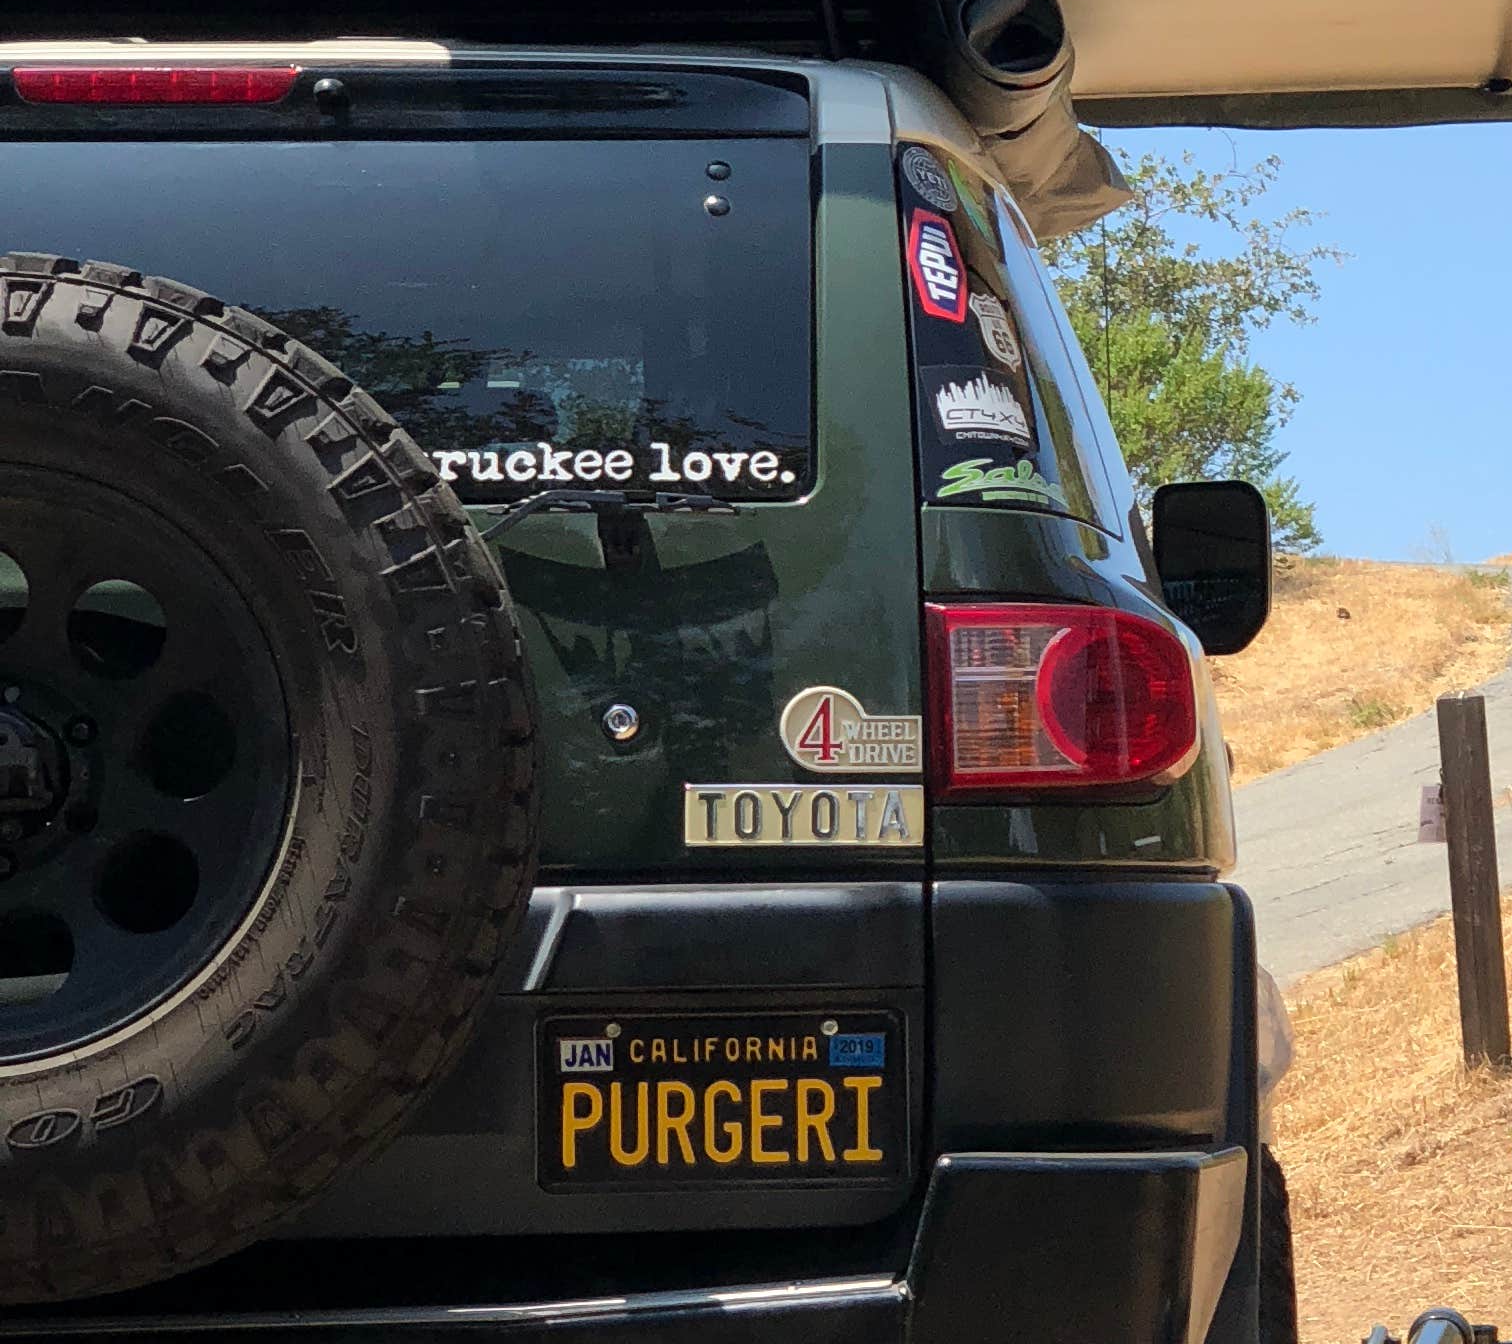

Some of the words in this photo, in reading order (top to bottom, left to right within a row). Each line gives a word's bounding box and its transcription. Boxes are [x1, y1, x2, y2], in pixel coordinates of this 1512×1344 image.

[919, 225, 959, 301] TEPUI
[946, 407, 1027, 429] CT4X4
[423, 442, 634, 482] ruckee
[649, 442, 797, 484] love.
[797, 694, 843, 764] 4
[842, 719, 917, 741] WHEEL
[848, 743, 917, 764] DRIVE
[697, 790, 910, 841] TOYOTA
[564, 1043, 612, 1068] JAN
[629, 1037, 818, 1064] CALIFORNIA
[840, 1039, 874, 1054] 2019
[562, 1076, 883, 1168] PURGERI
